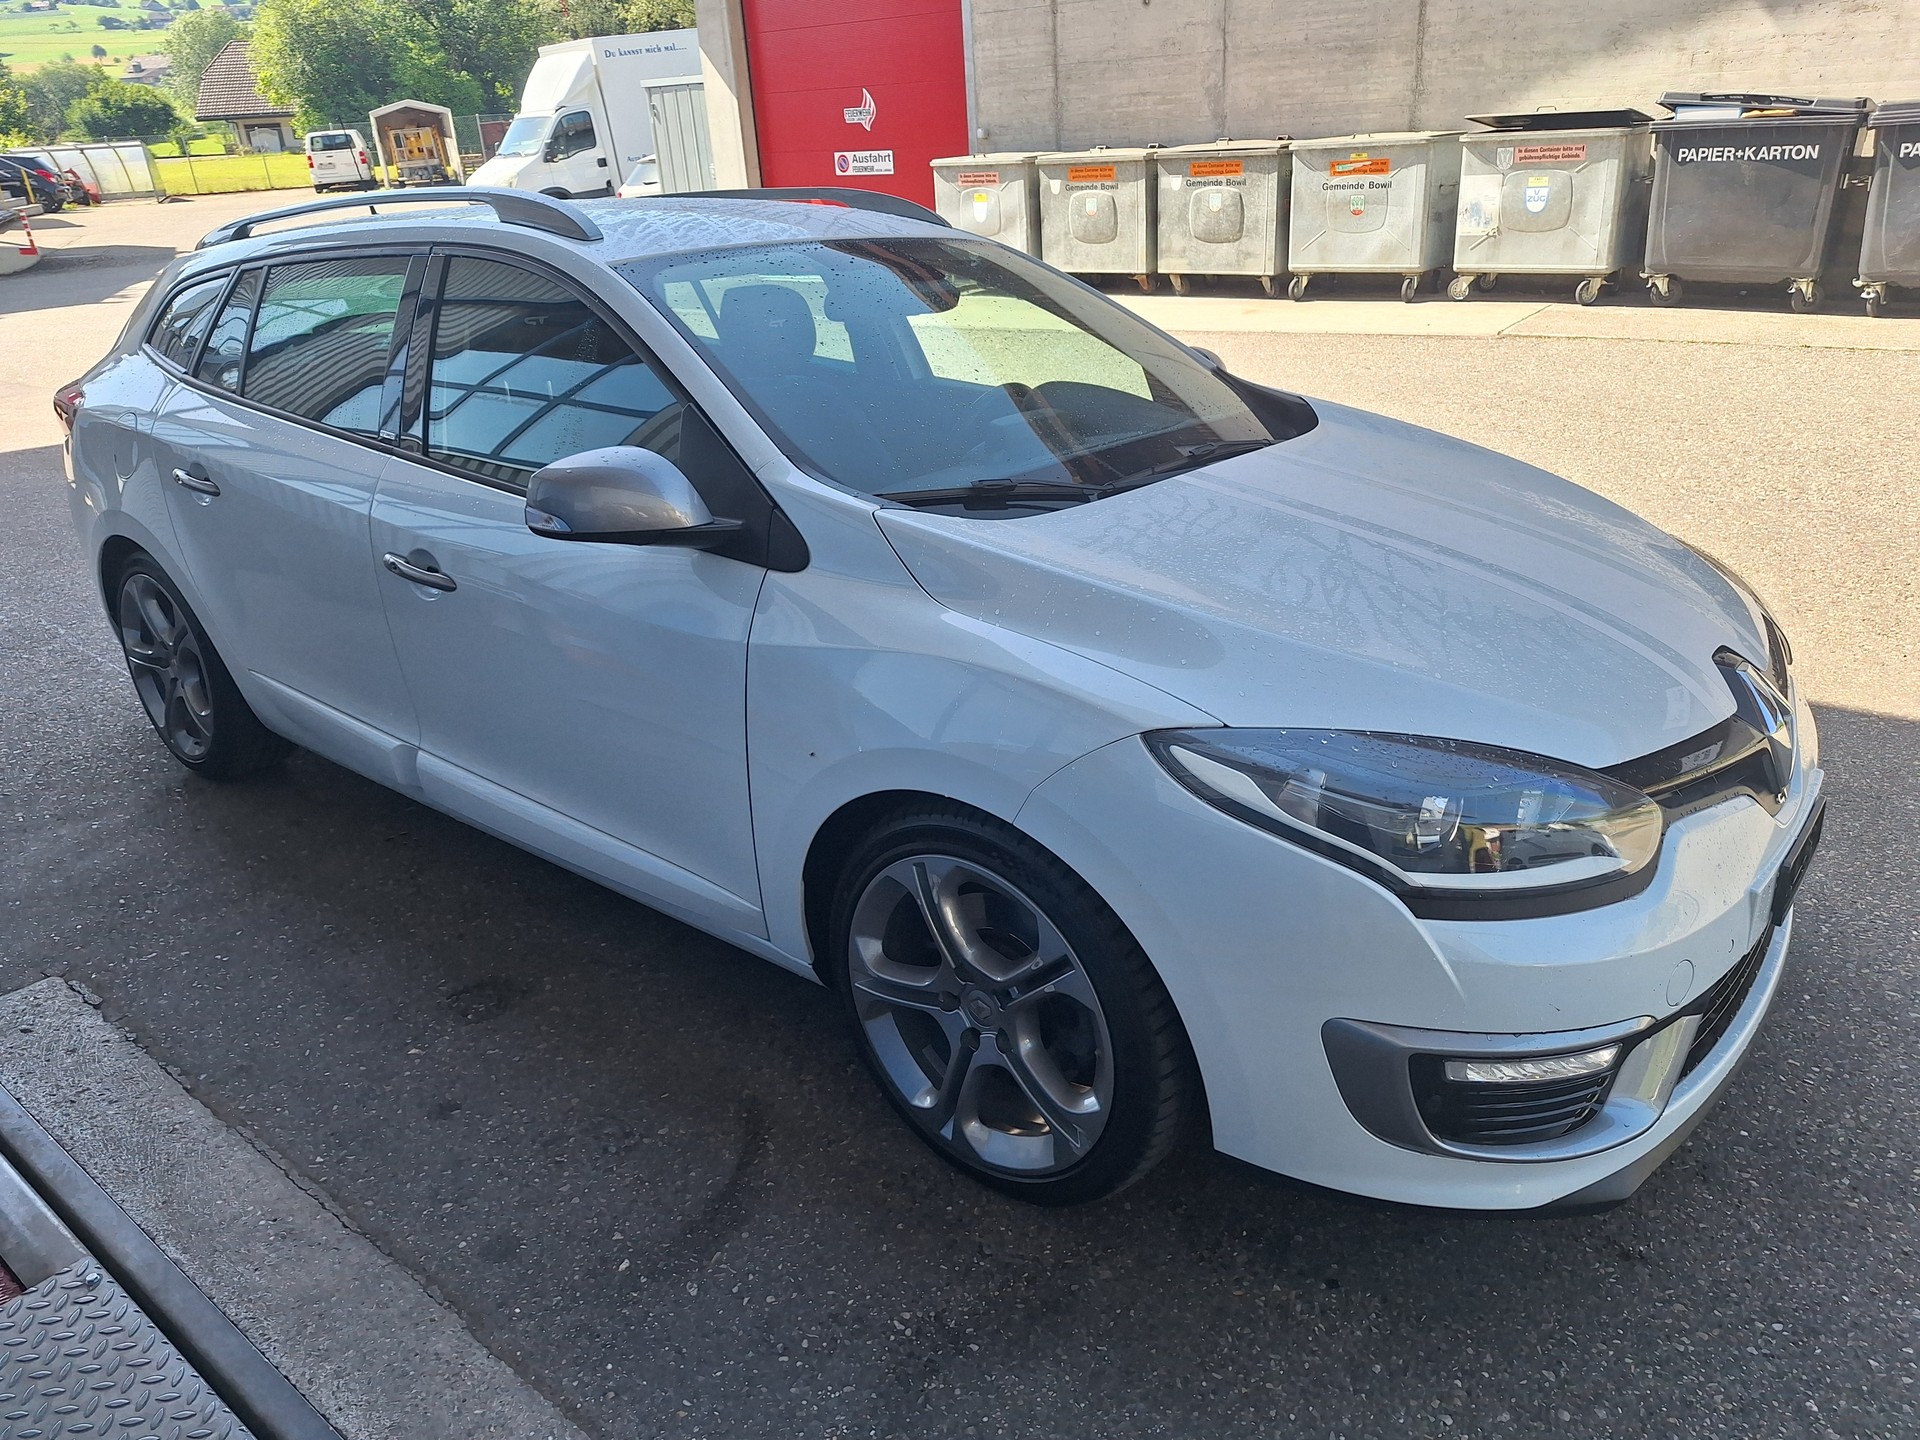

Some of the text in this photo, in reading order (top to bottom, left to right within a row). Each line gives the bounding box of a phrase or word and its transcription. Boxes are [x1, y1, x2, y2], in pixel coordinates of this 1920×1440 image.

[1677, 144, 1820, 162] PAPIER+KARTON
[852, 154, 891, 163] Ausfahrt
[1065, 182, 1119, 192] Gemeinde Bowil
[1186, 178, 1247, 187] Gemeinde Bowil
[1321, 180, 1393, 191] Gemeinde Bowil
[1527, 195, 1546, 203] ZUG
